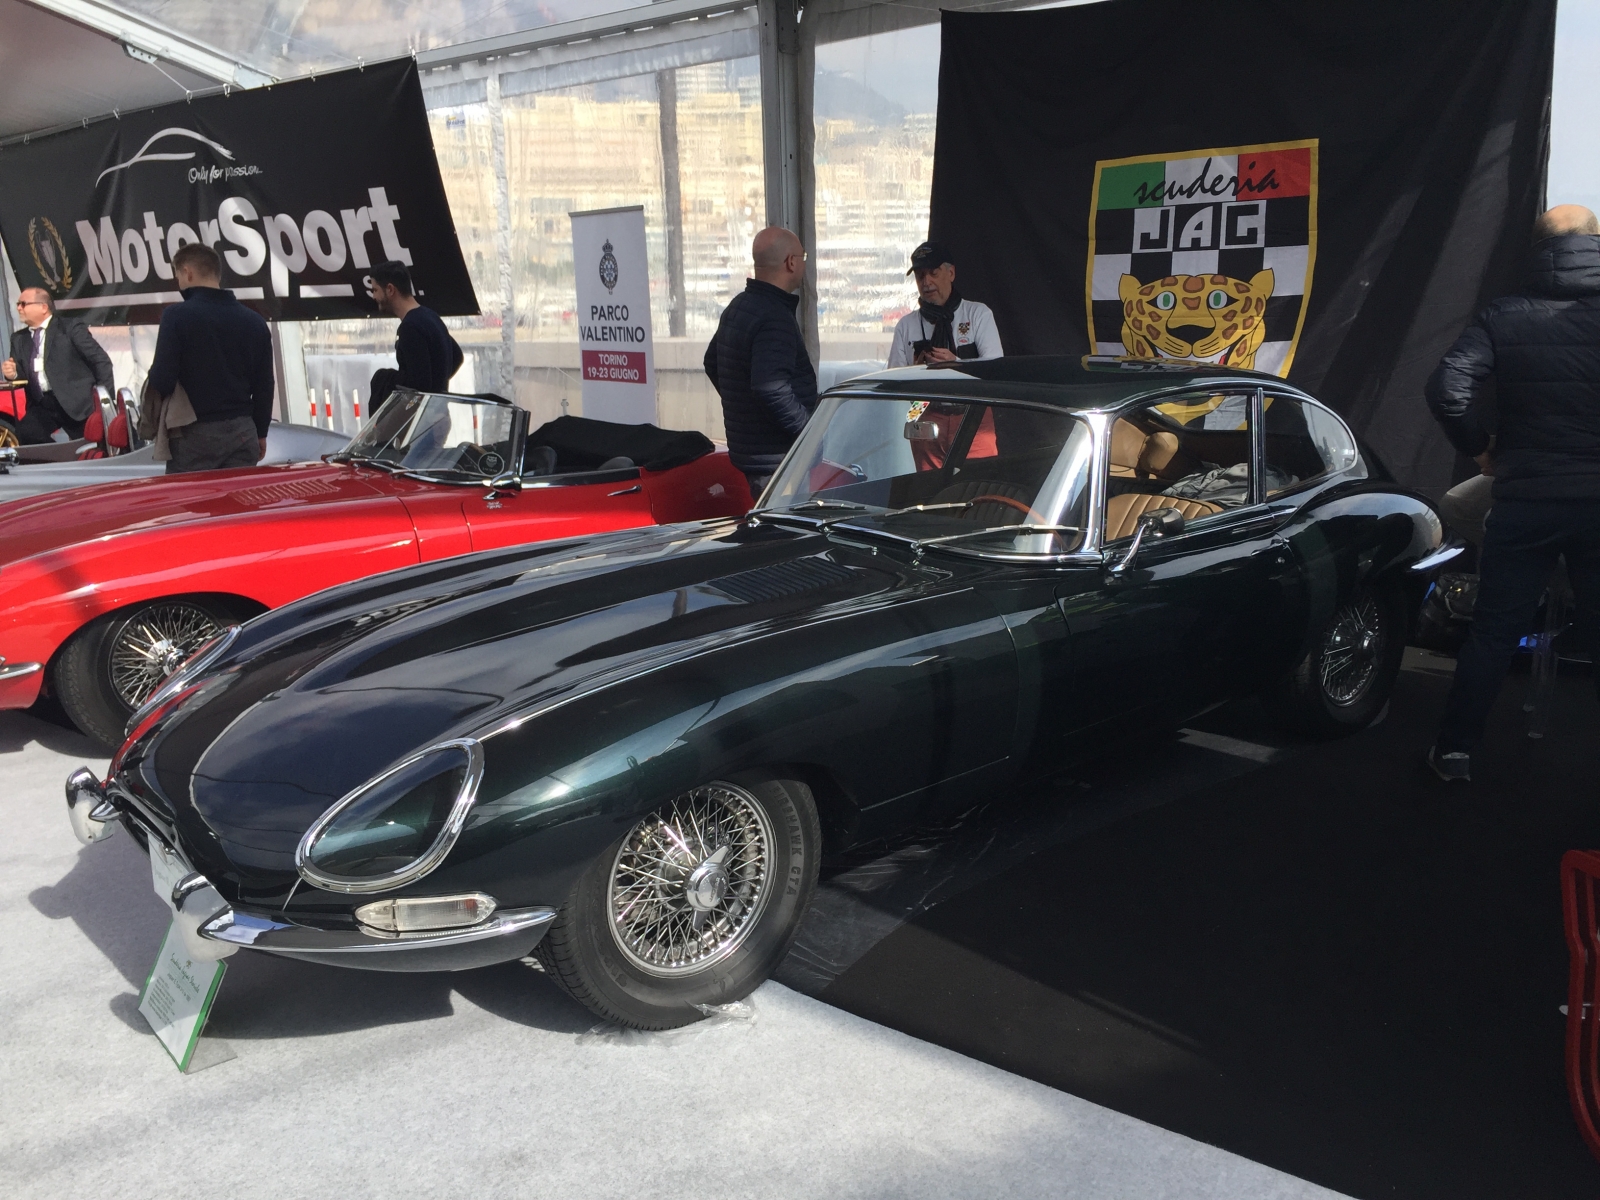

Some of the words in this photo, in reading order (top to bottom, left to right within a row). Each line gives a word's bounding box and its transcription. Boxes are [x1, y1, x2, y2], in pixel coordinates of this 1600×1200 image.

[188, 165, 209, 185] Only
[210, 165, 223, 183] for
[1133, 158, 1279, 204] scuderia
[1136, 203, 1262, 251] JAG
[590, 305, 629, 321] PARCO
[580, 326, 645, 343] VALENTINO
[598, 354, 628, 366] TORINO
[587, 367, 609, 379] 19-23
[609, 370, 639, 381] GIUGNO
[786, 866, 802, 896] GTA
